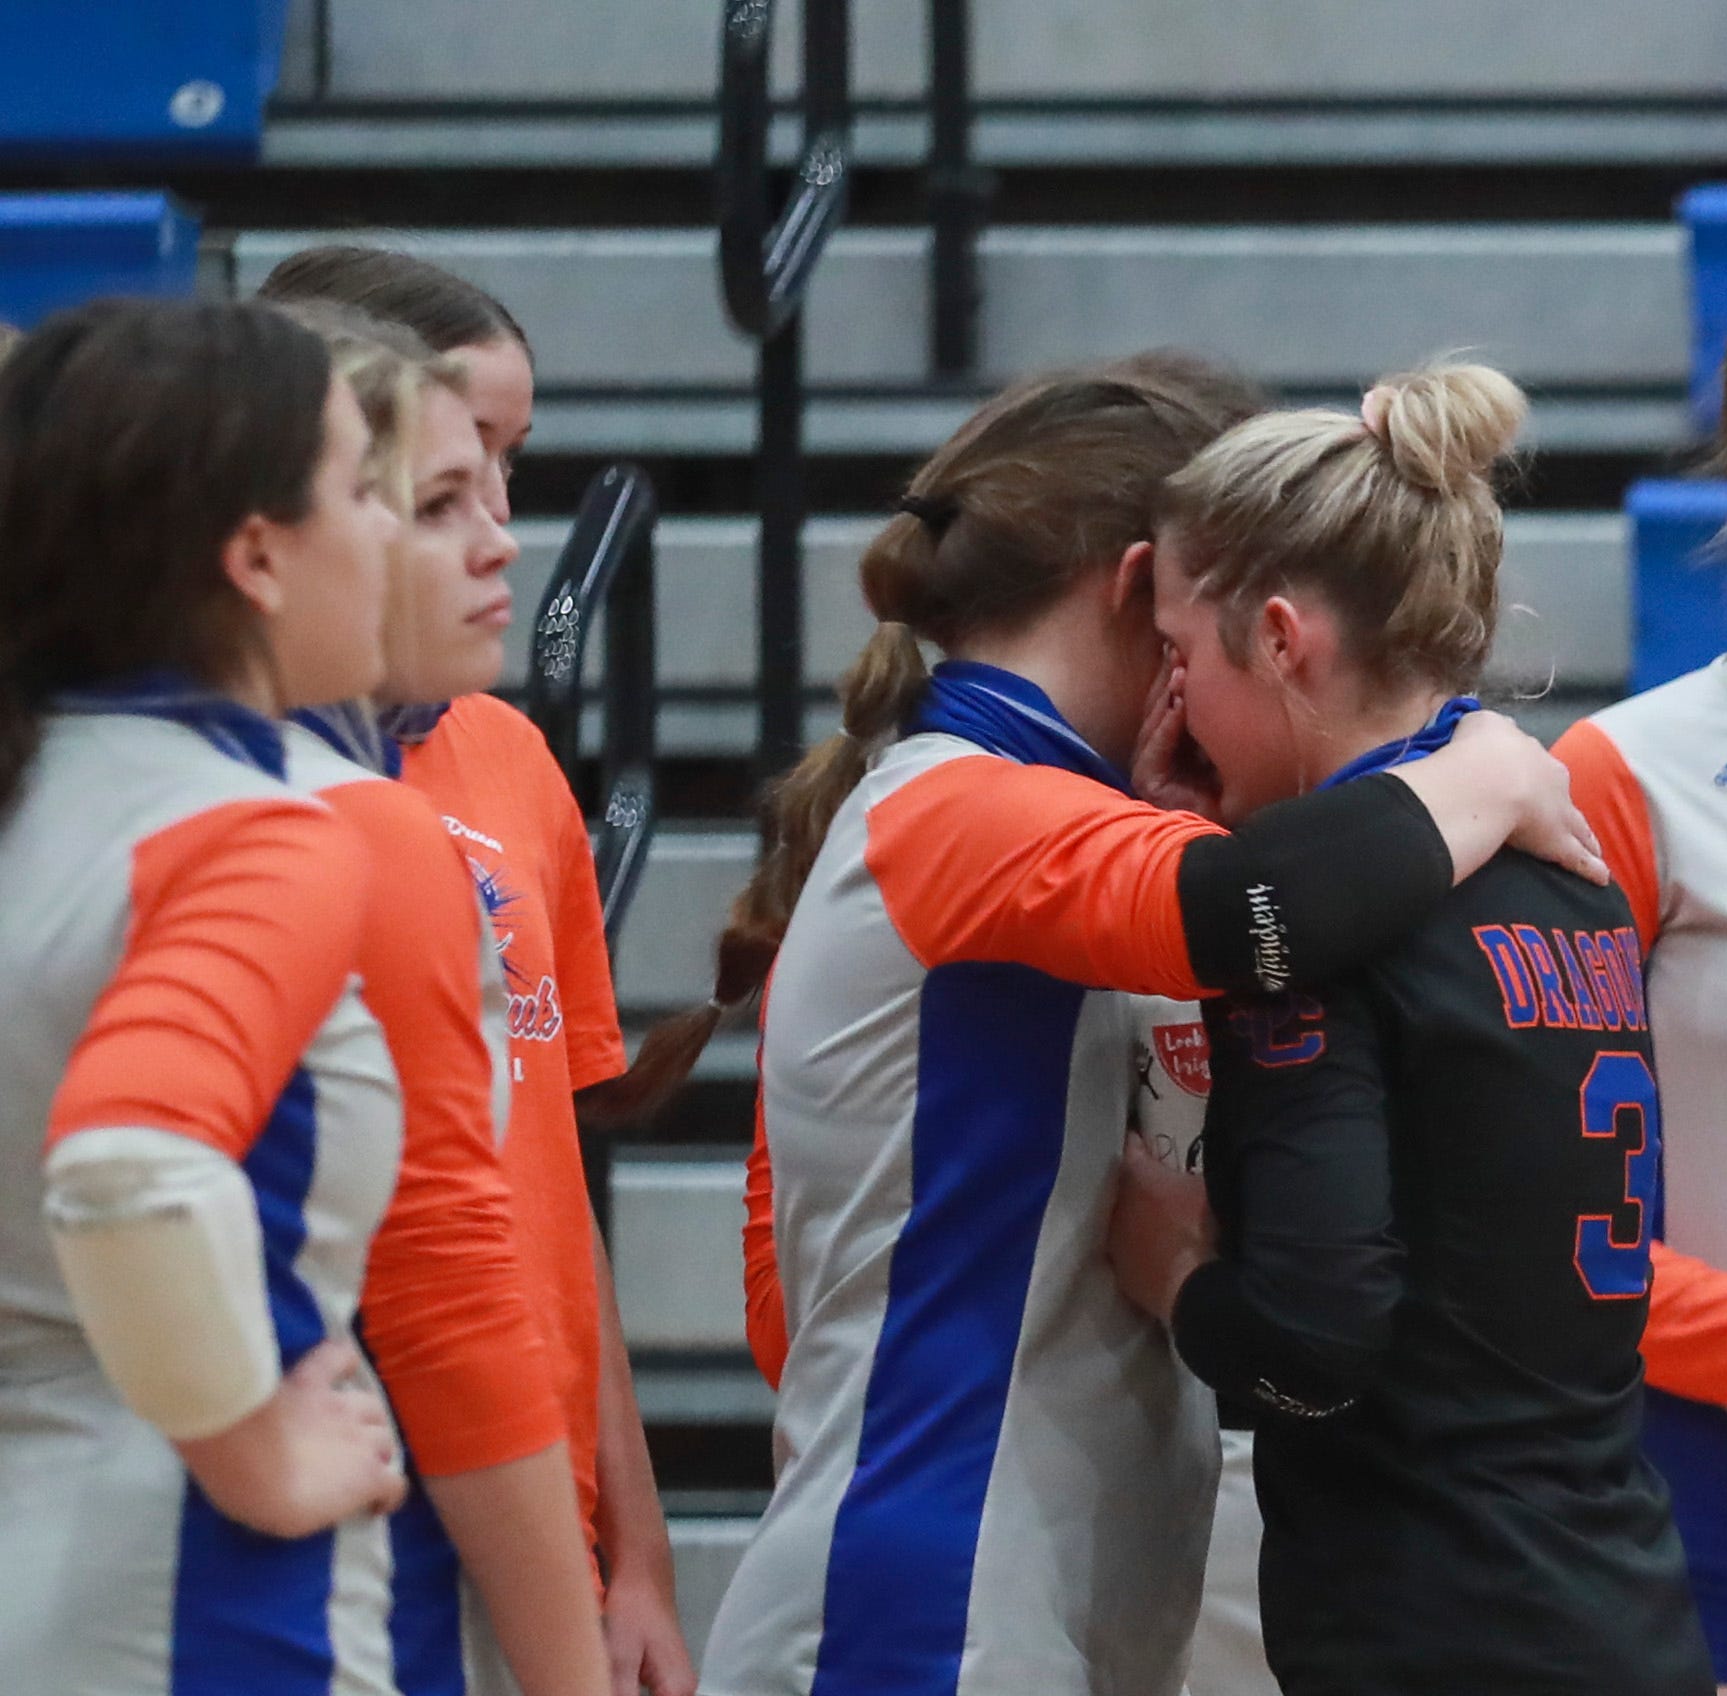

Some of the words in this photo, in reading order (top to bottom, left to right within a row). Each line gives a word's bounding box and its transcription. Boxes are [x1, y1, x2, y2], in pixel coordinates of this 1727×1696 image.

[502, 974, 563, 1042] eek
[1471, 923, 1649, 1032] DRAGON
[1573, 1049, 1659, 1300] 3
